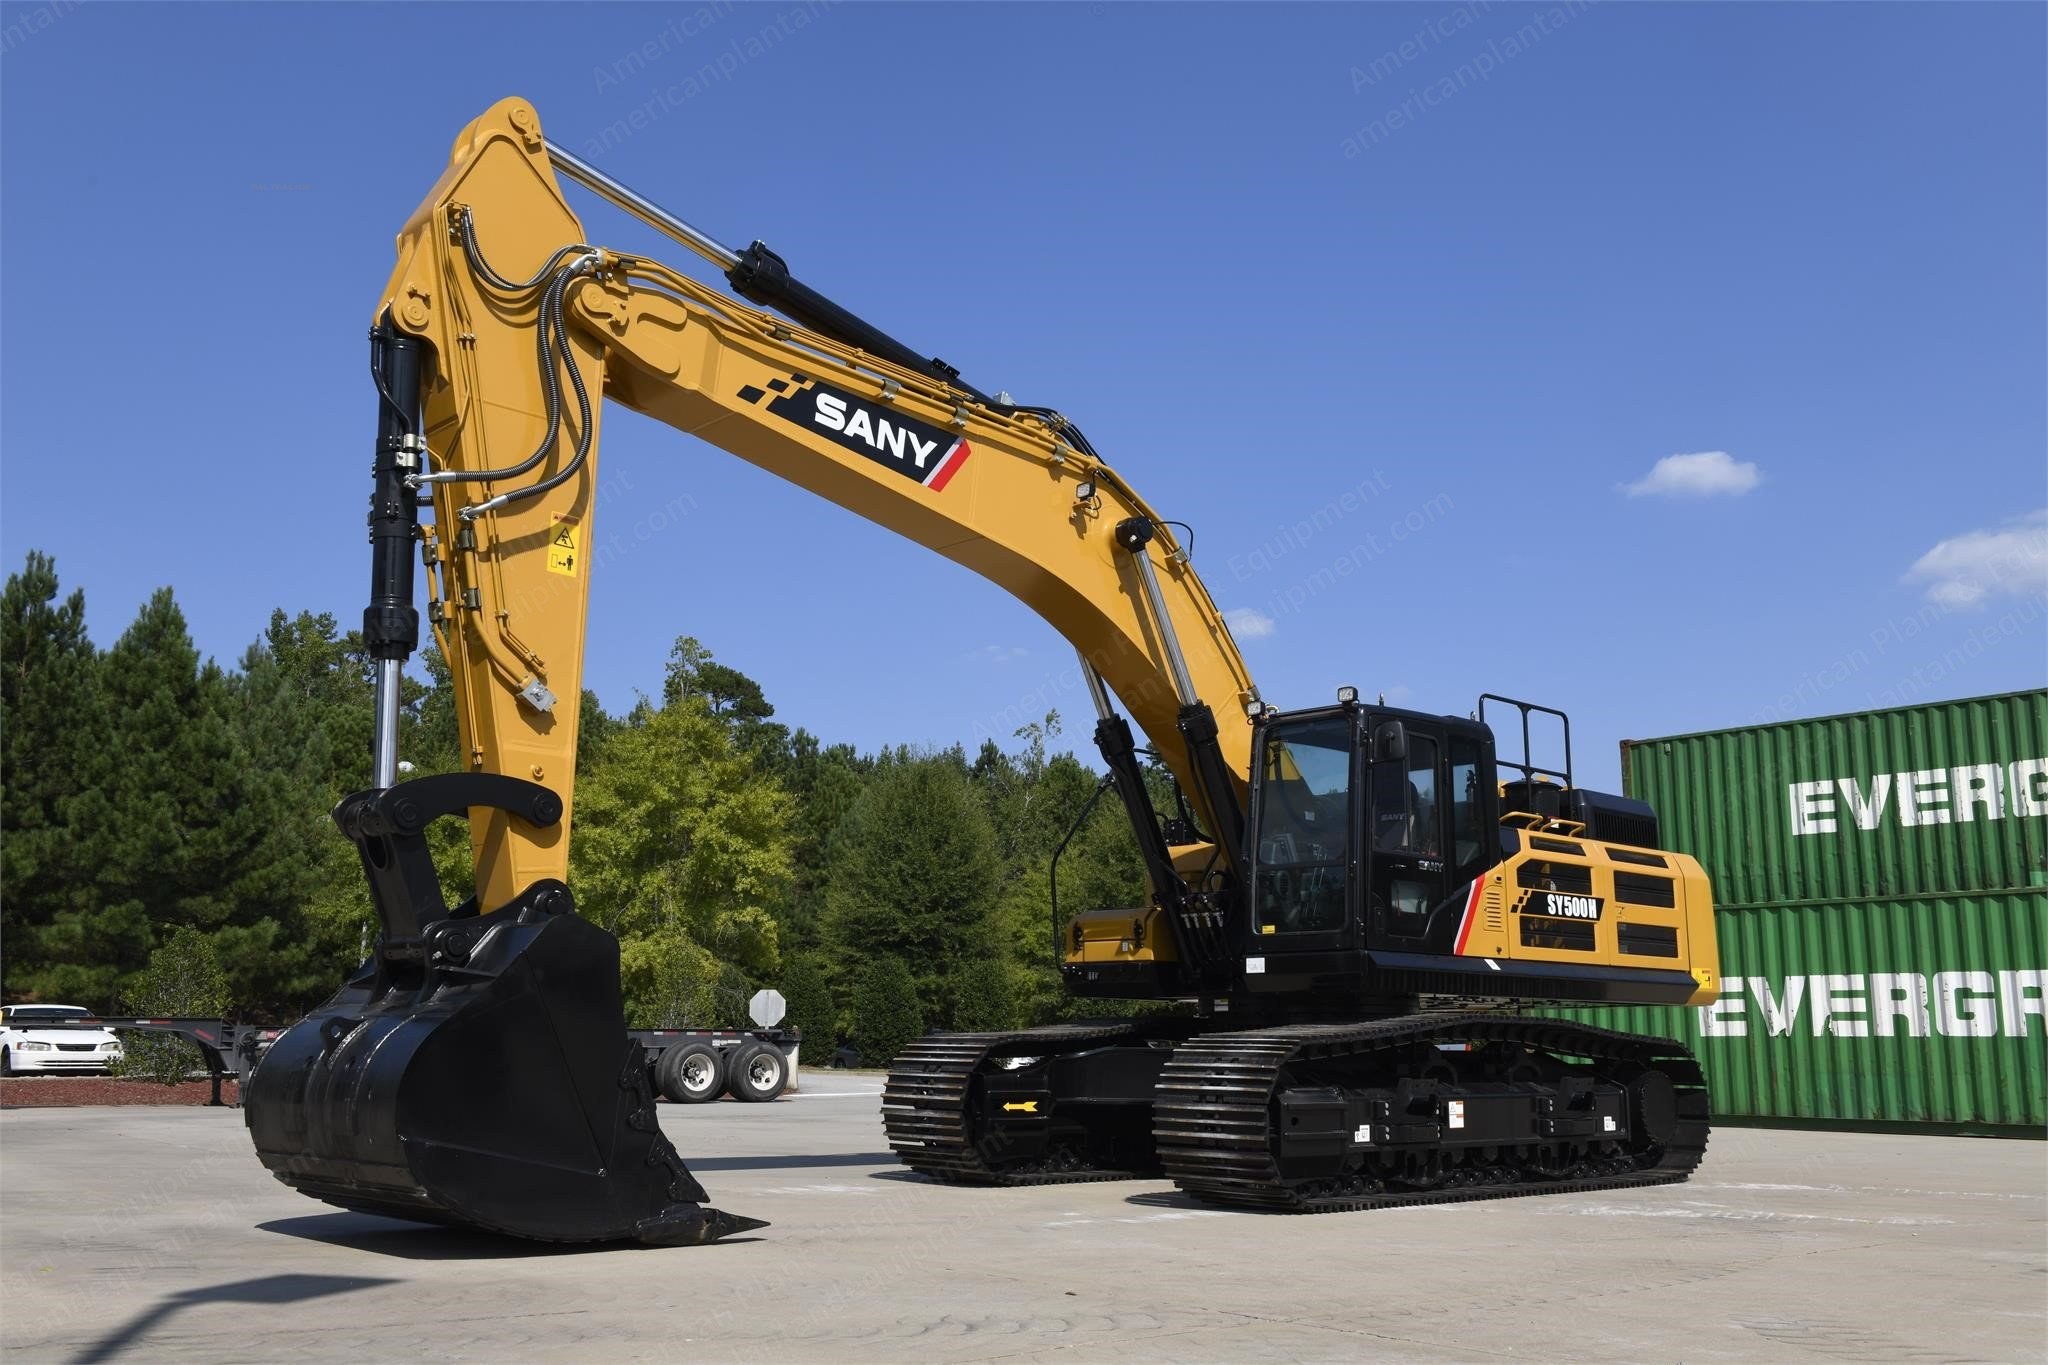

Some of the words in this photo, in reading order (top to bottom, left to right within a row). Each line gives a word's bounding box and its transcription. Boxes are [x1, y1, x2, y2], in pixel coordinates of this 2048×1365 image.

[814, 392, 938, 469] SANY
[1789, 757, 2047, 836] EVERG
[1547, 893, 1598, 919] SY500H
[1698, 969, 2047, 1038] EVERGR
